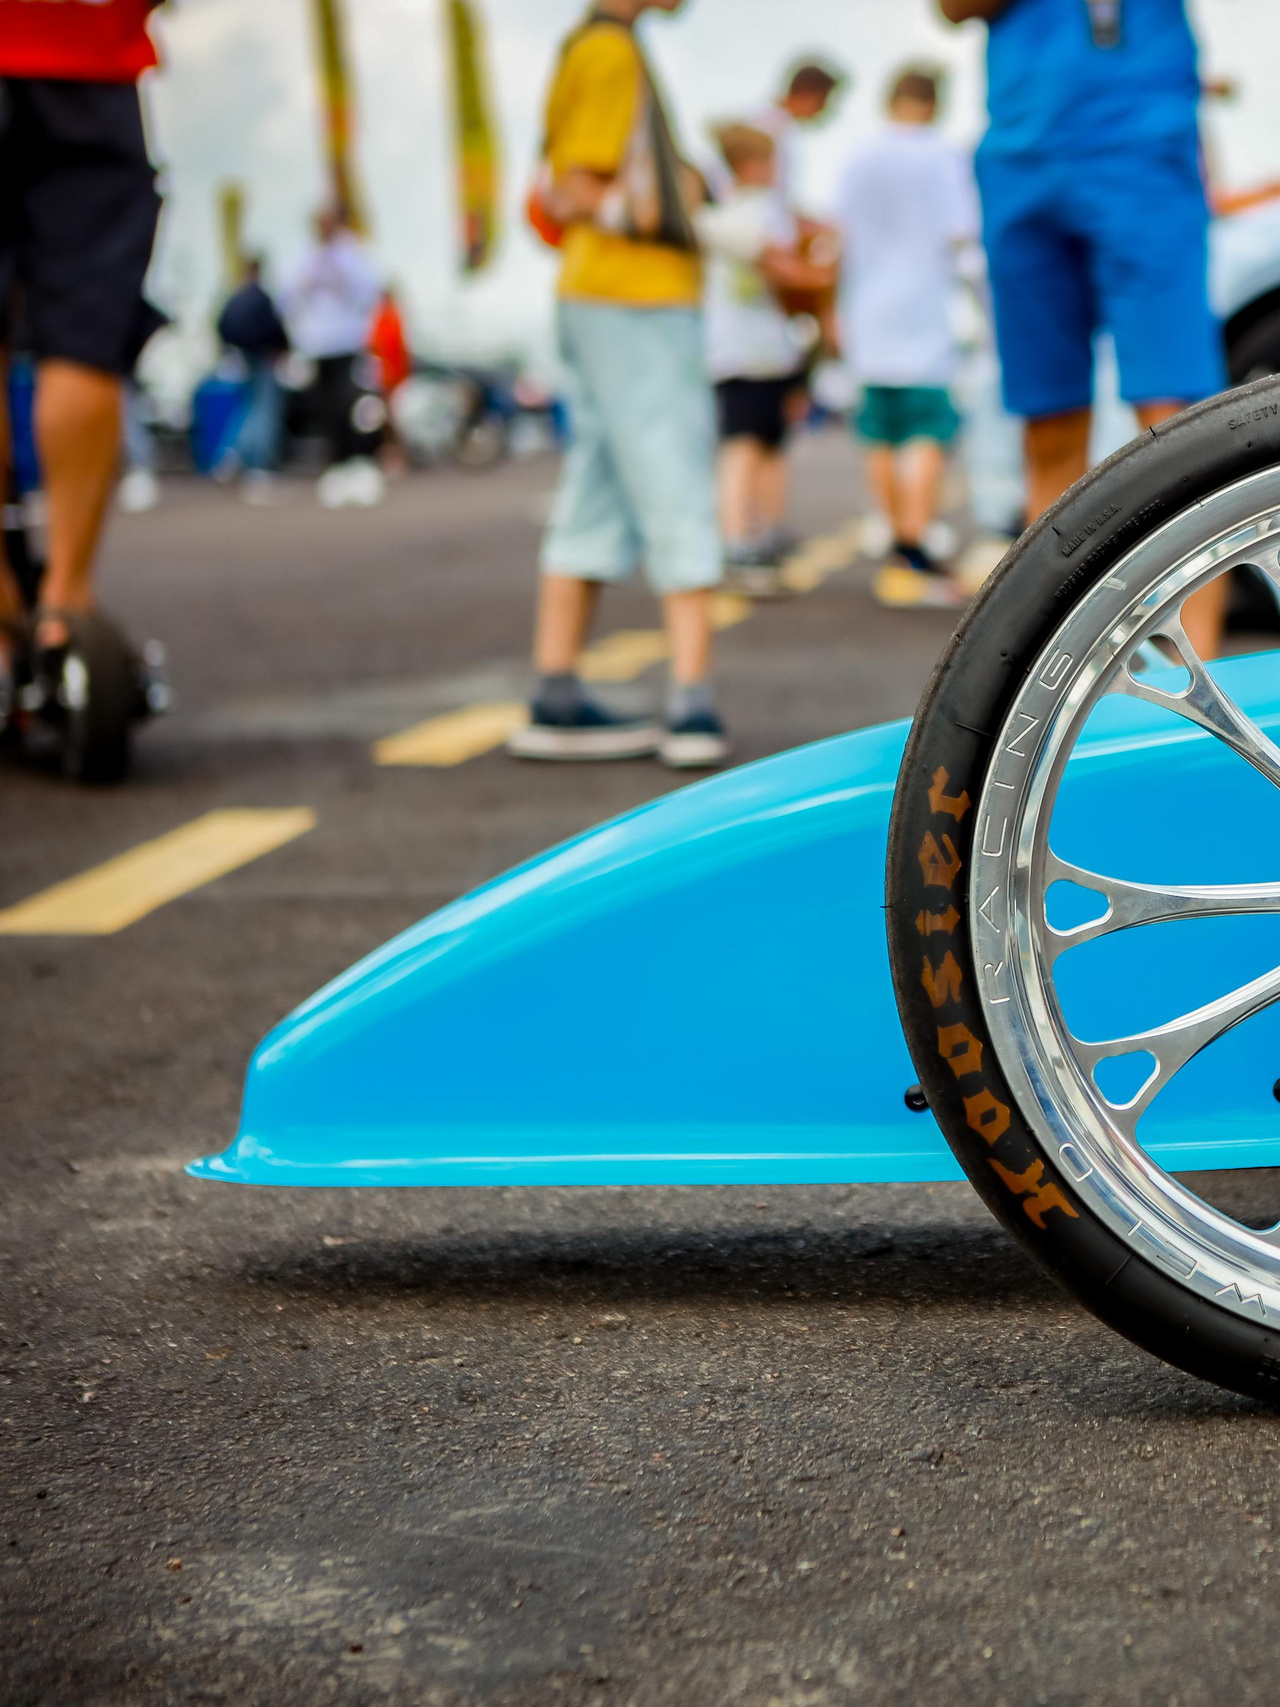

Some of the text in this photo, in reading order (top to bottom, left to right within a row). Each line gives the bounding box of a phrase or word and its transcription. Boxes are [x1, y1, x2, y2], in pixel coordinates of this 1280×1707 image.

[1227, 402, 1278, 430] SAFETY
[1061, 503, 1122, 558] MADE IN U.S.A.
[978, 648, 1269, 1318] WELD RACING
